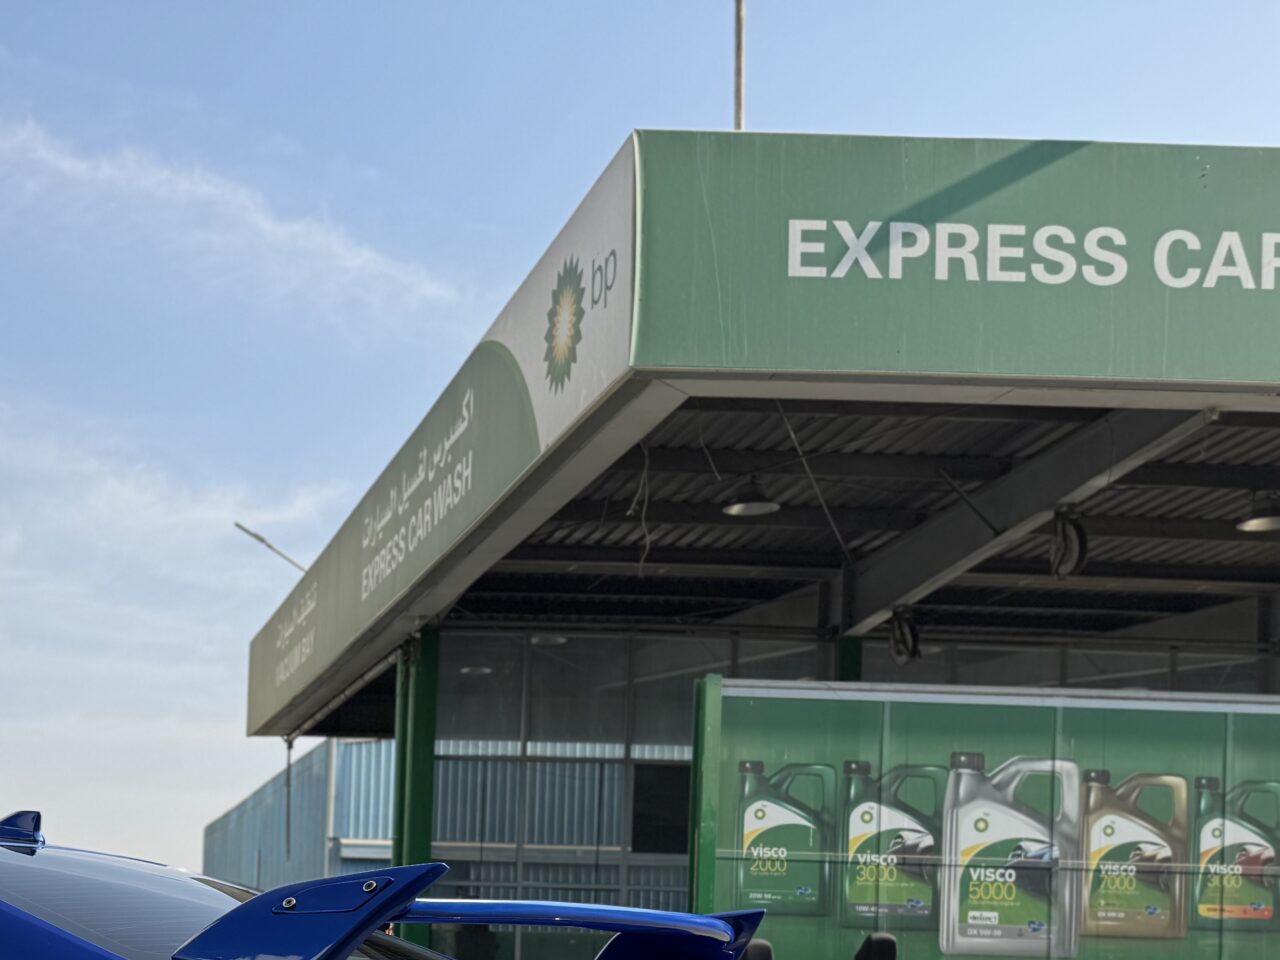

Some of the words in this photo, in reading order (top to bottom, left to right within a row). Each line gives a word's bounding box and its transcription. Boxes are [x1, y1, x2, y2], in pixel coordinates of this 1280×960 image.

[788, 218, 1128, 286] EXPRESS
[591, 248, 617, 310] bp
[361, 526, 406, 601] EXPRESS
[407, 499, 432, 552] CAR
[433, 450, 473, 526] WASH
[750, 858, 787, 872] 2000
[856, 865, 897, 882] 3000
[969, 881, 1016, 901] 5000
[1100, 875, 1136, 890] 7000
